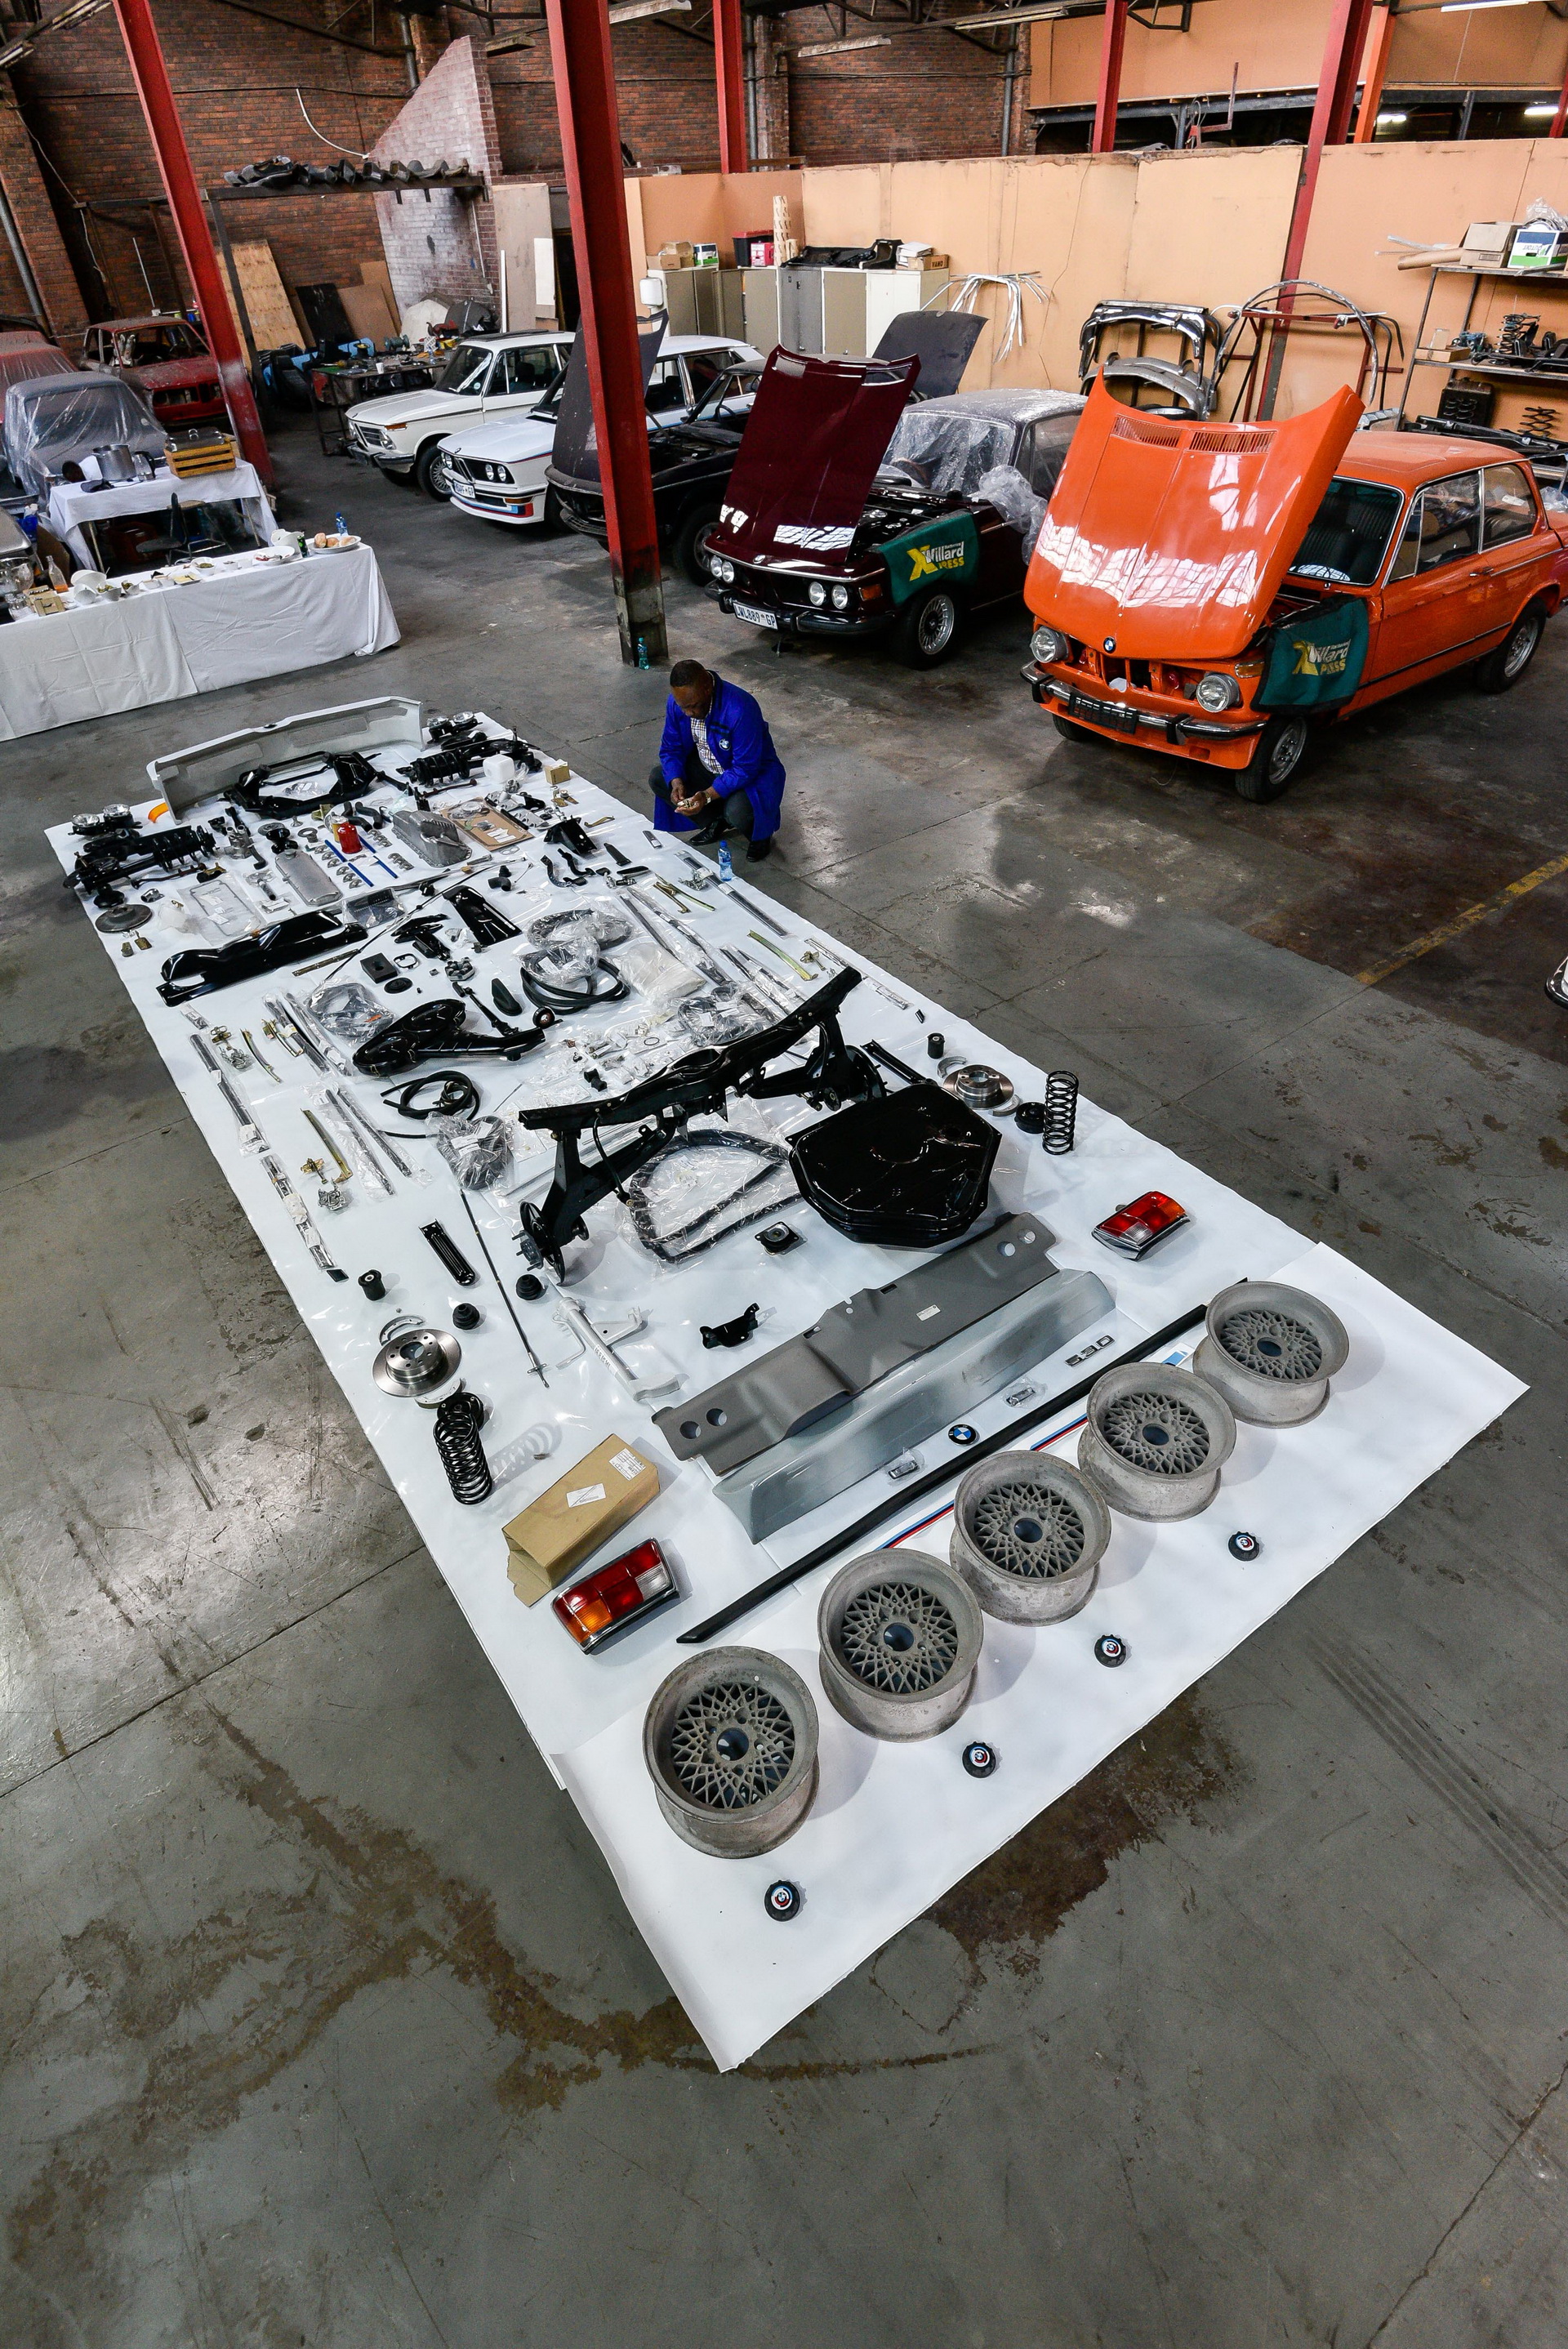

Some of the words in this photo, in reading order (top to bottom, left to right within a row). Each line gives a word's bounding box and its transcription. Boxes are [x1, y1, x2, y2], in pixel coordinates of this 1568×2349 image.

[921, 541, 964, 564] Willard
[765, 614, 776, 626] GP
[1320, 658, 1347, 675] PESS
[1064, 1335, 1116, 1367] 530
